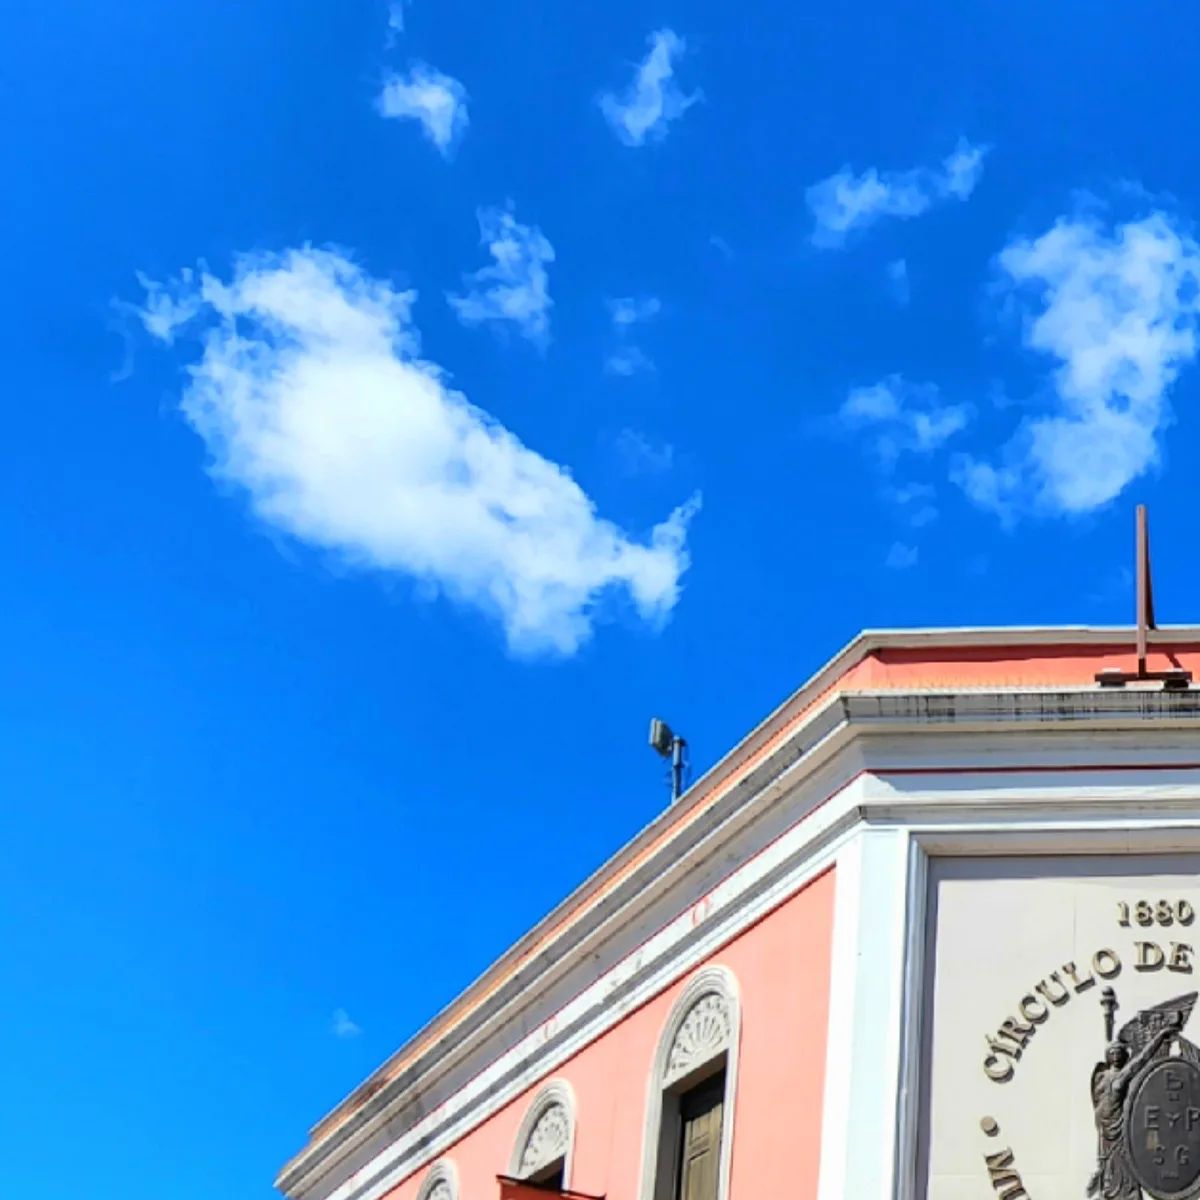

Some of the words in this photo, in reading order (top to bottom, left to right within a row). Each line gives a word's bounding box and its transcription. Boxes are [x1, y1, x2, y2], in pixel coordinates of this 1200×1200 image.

[1117, 899, 1196, 928] 1880
[983, 947, 1122, 1083] CÍRCULO
[1133, 940, 1194, 974] DE
